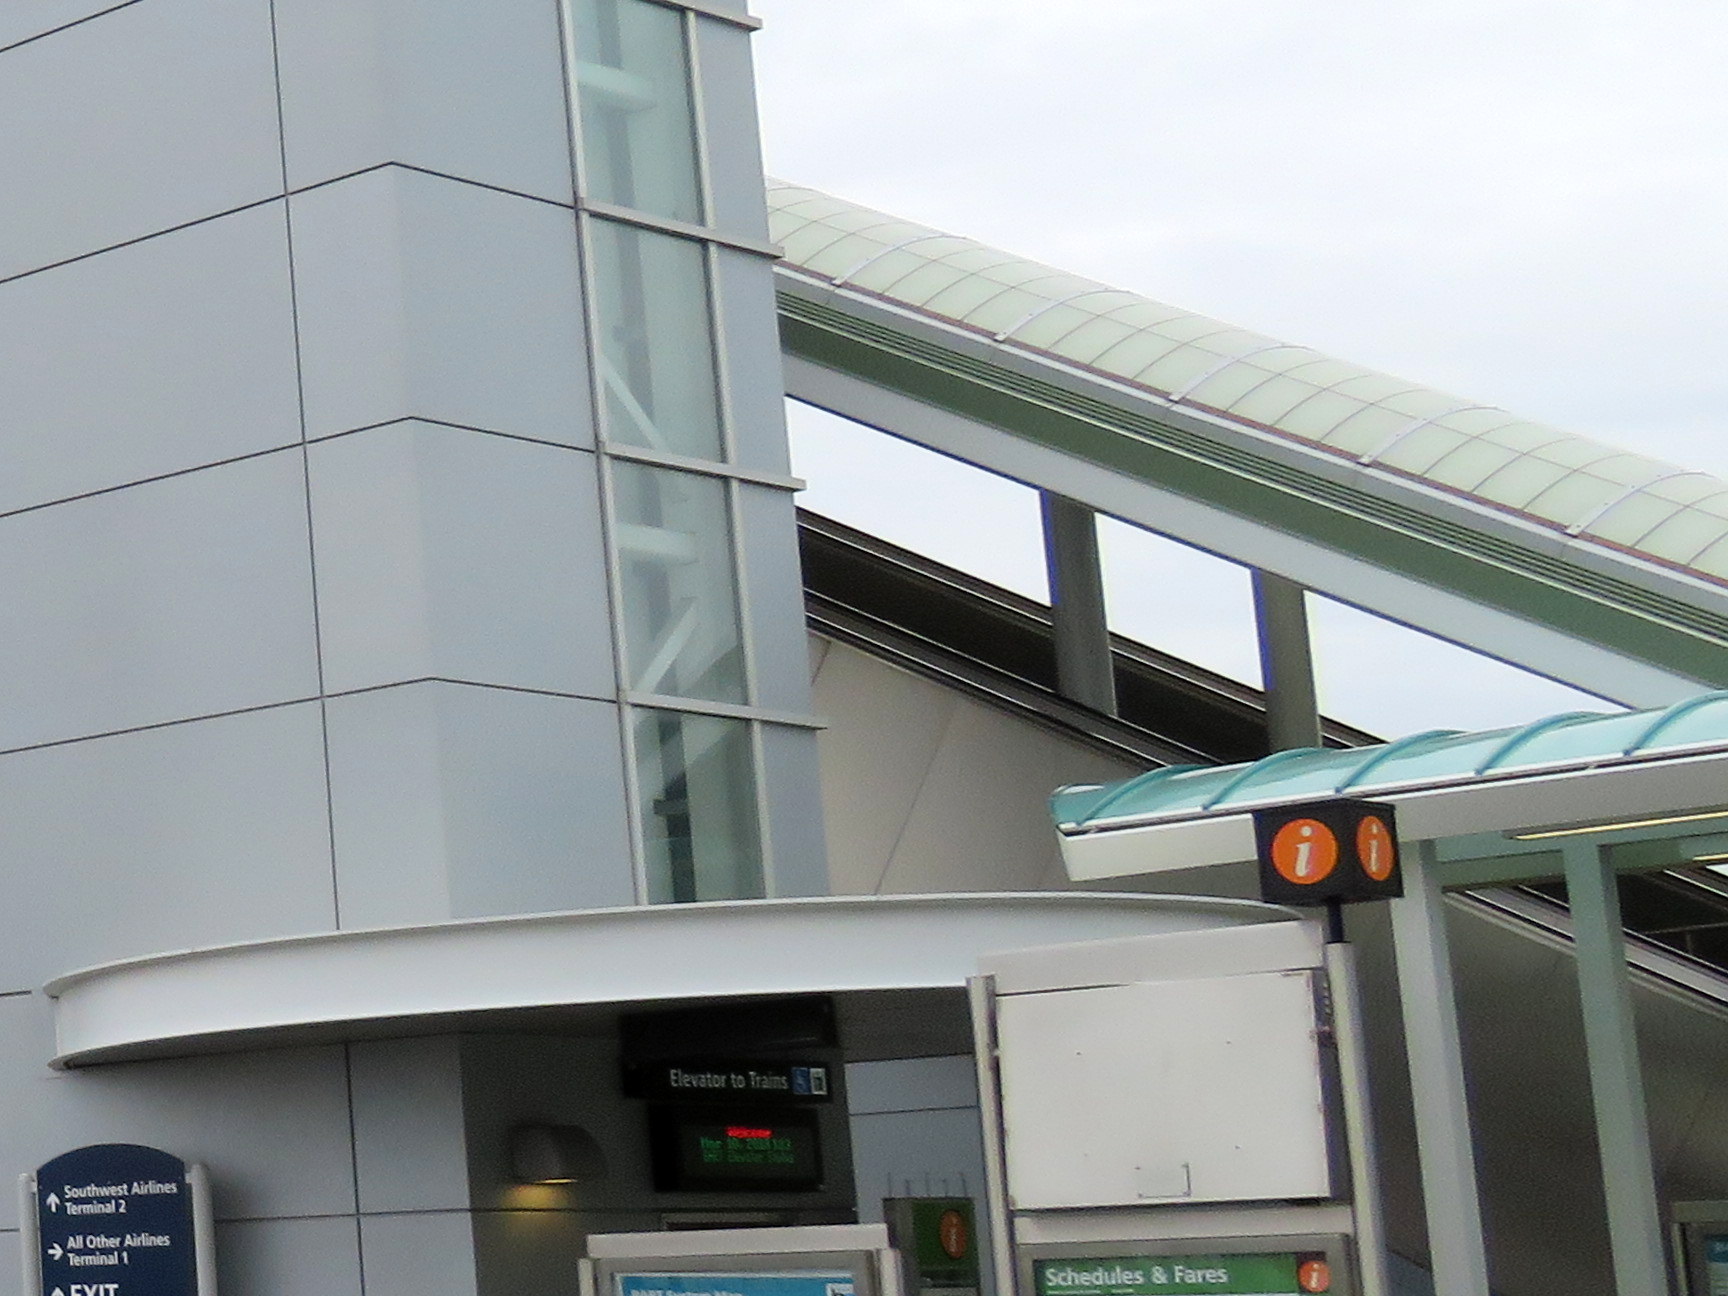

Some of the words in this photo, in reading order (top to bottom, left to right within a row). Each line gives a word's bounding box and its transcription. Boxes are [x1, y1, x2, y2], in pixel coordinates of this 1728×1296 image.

[669, 1068, 727, 1088] Elevator
[730, 1072, 745, 1088] to
[748, 1070, 789, 1090] Trains
[64, 1183, 129, 1199] Southwest
[131, 1180, 178, 1195] Airlines
[65, 1200, 116, 1215] Terminal
[118, 1199, 127, 1213] 2
[66, 1235, 84, 1250] All
[86, 1233, 121, 1249] Other
[124, 1232, 171, 1247] Airlines
[67, 1251, 119, 1266] Terminal
[122, 1251, 129, 1264] 1
[1045, 1266, 1143, 1287] Schedules
[1150, 1265, 1168, 1285] &
[1174, 1264, 1229, 1284] Fares
